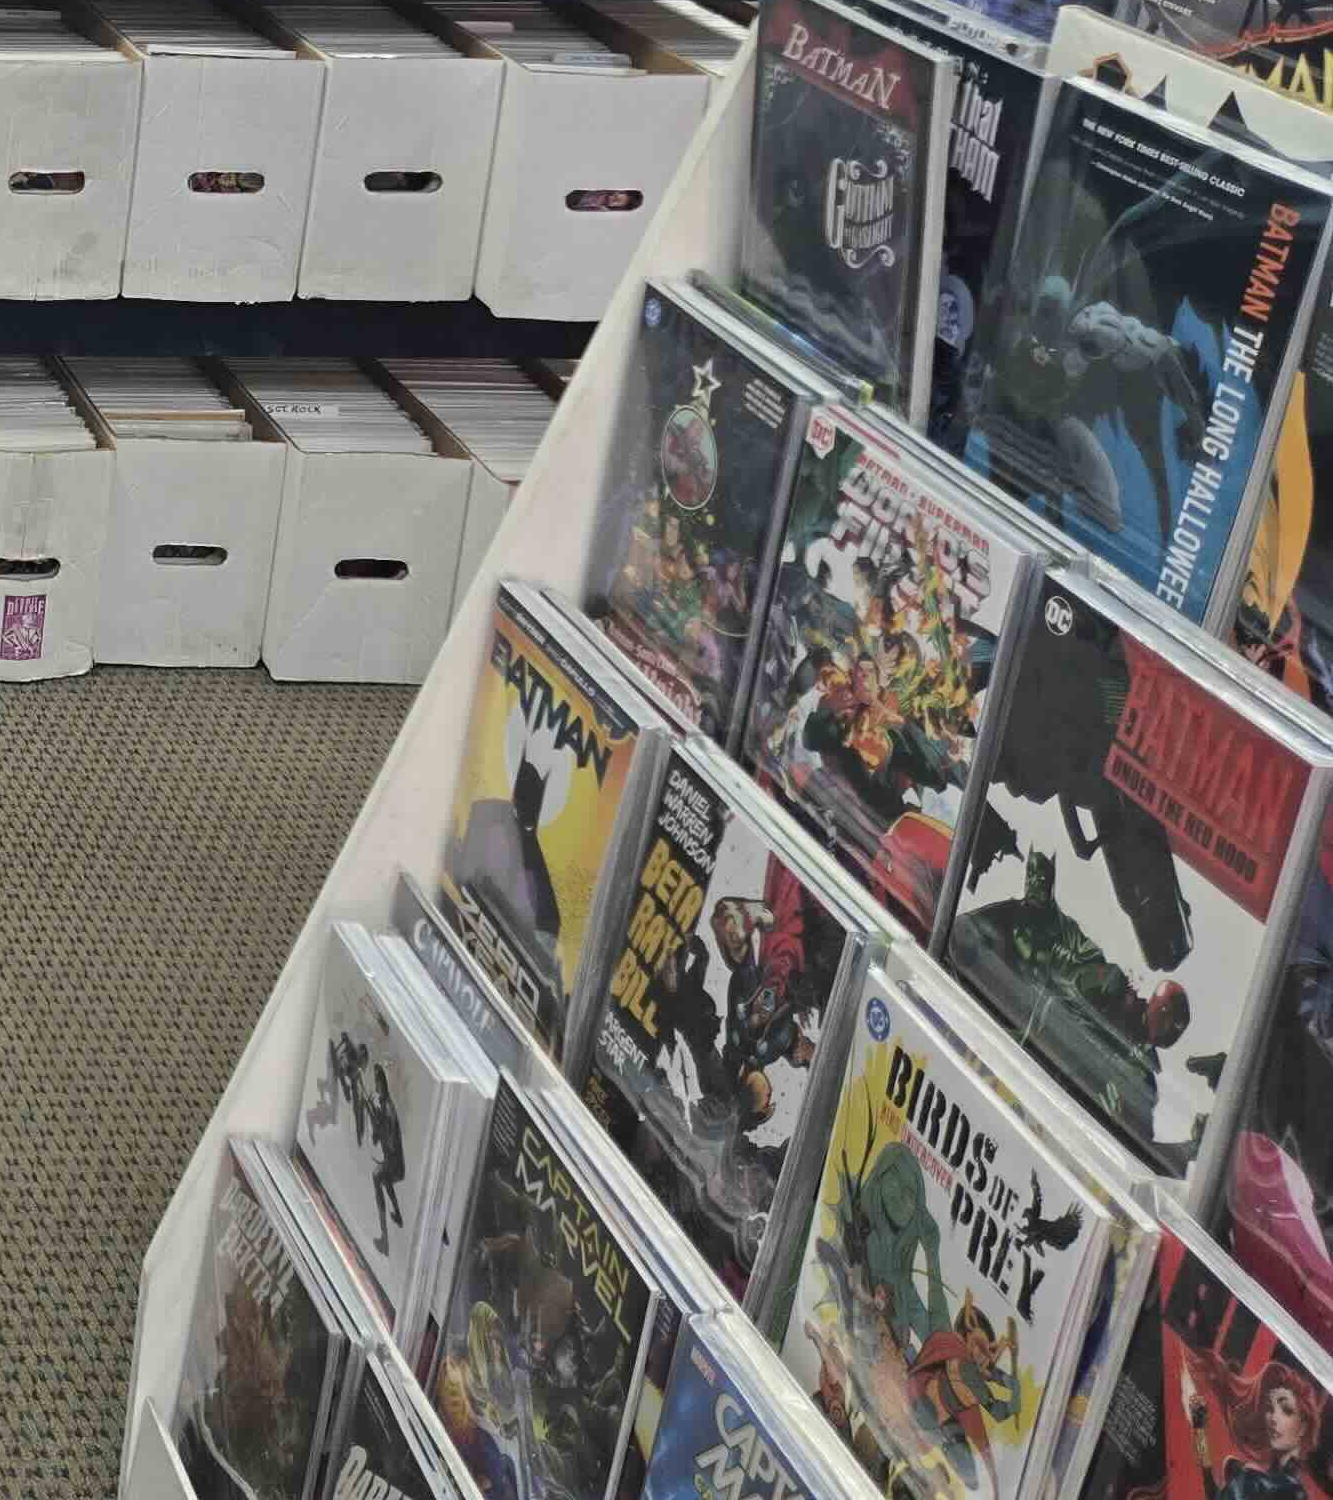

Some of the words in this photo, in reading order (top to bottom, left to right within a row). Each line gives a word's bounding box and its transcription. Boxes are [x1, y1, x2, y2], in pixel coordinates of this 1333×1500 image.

[783, 21, 901, 110] BATMAN
[1209, 174, 1246, 198] CLASSIC
[1240, 201, 1301, 322] BATMAN
[1222, 325, 1264, 384] THE
[811, 419, 834, 446] DC
[1201, 383, 1246, 460] LONG
[856, 452, 909, 494] BATMAN
[917, 494, 990, 550] SUPERMAN
[1045, 600, 1073, 631] DC
[490, 633, 614, 790] BATMAN
[664, 790, 714, 847] WARREN
[668, 768, 712, 823] DANIEL
[1110, 754, 1160, 809] UNDER
[1185, 807, 1215, 848] RED
[1213, 829, 1260, 884] HOOD
[657, 813, 717, 876] JOHNSON
[640, 836, 704, 935] BETA
[611, 946, 662, 1040] BILL
[598, 1028, 626, 1075] STAR
[603, 1007, 649, 1072] ARGENT
[885, 1044, 999, 1193] BIRDS
[522, 1126, 630, 1295] CAPTAIN
[988, 1174, 1020, 1221] OF
[949, 1182, 1046, 1328] PREY
